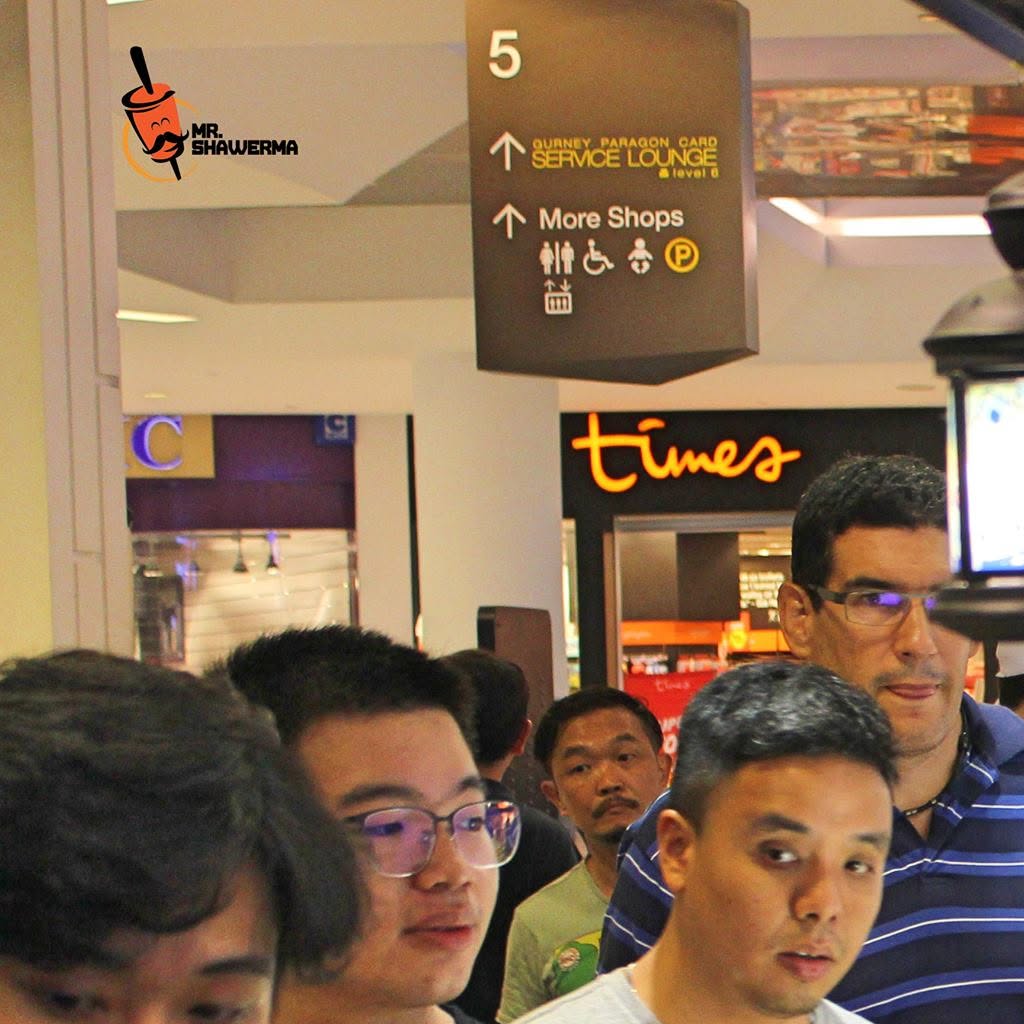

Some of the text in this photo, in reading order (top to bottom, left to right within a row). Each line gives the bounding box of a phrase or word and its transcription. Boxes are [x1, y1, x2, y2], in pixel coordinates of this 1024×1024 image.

[488, 29, 522, 79] 5
[532, 136, 718, 150] GURNEY PARAGON CARD
[531, 148, 718, 169] SERVICE LOUNGE
[672, 168, 706, 178] level
[539, 206, 684, 232] More Shops
[572, 412, 800, 492] times
